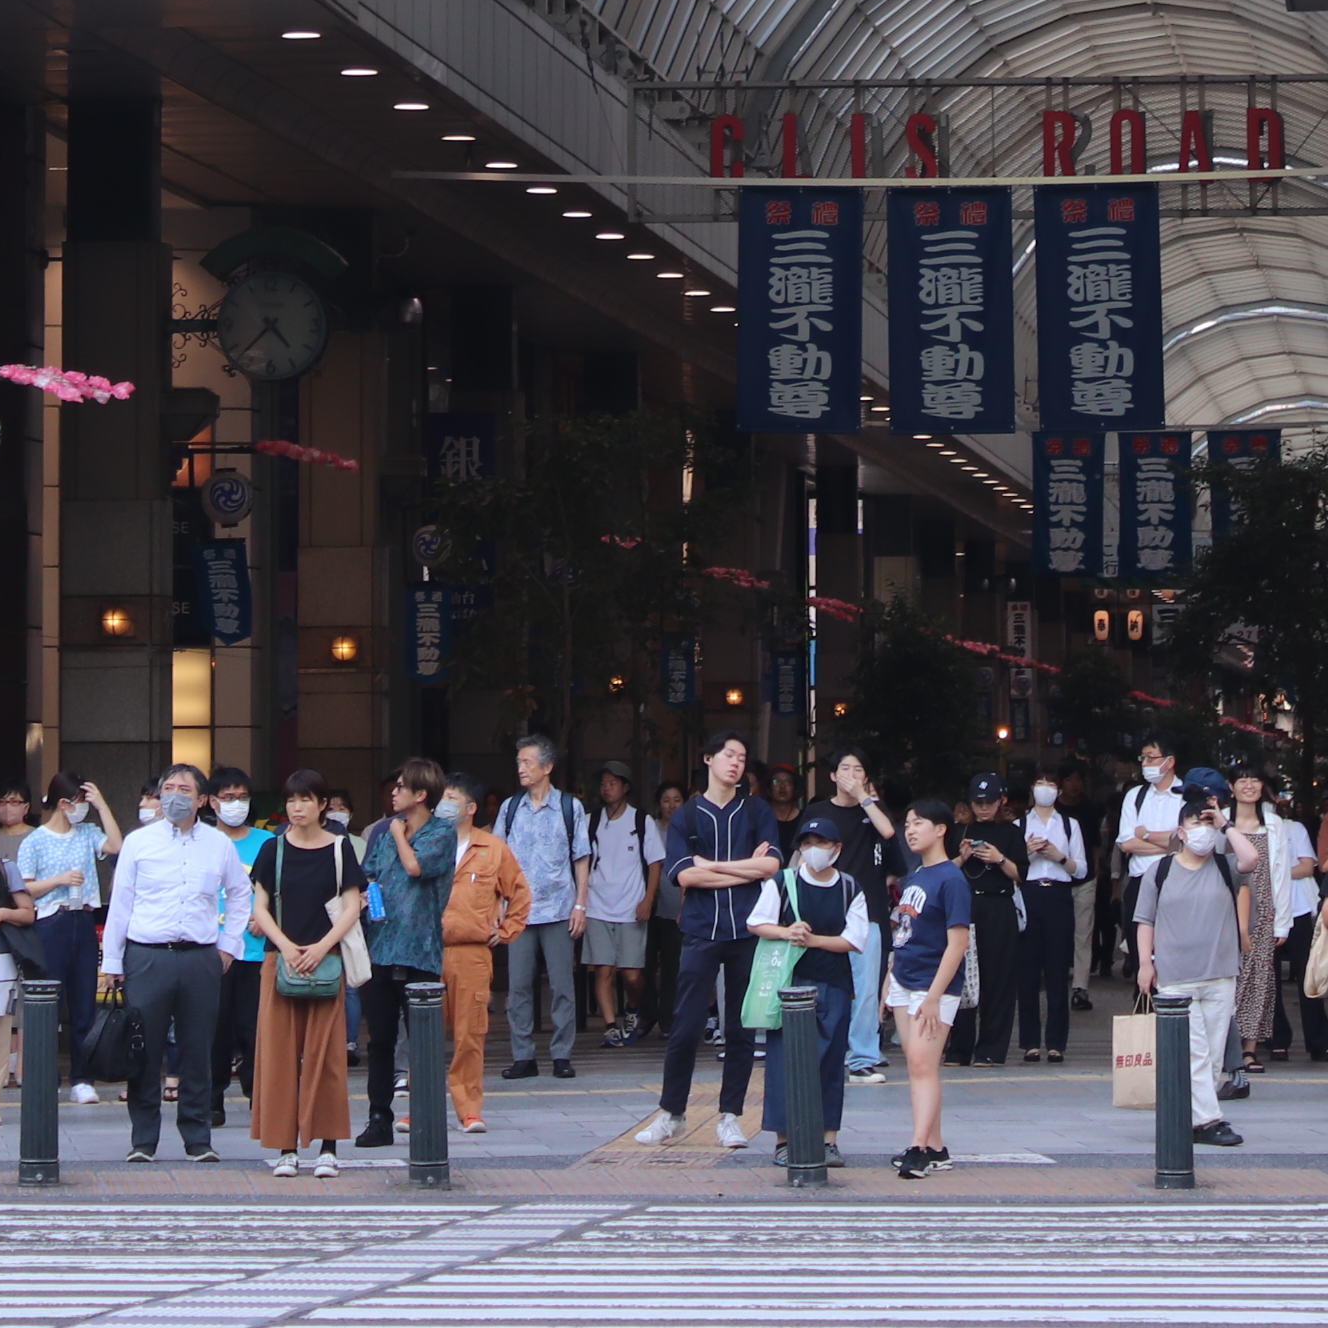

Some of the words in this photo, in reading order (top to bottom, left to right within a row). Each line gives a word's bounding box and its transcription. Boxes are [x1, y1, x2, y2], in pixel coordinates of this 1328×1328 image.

[710, 112, 939, 182] CLIS
[1043, 108, 1285, 183] ROAD
[1115, 1051, 1154, 1070] 無印良品
